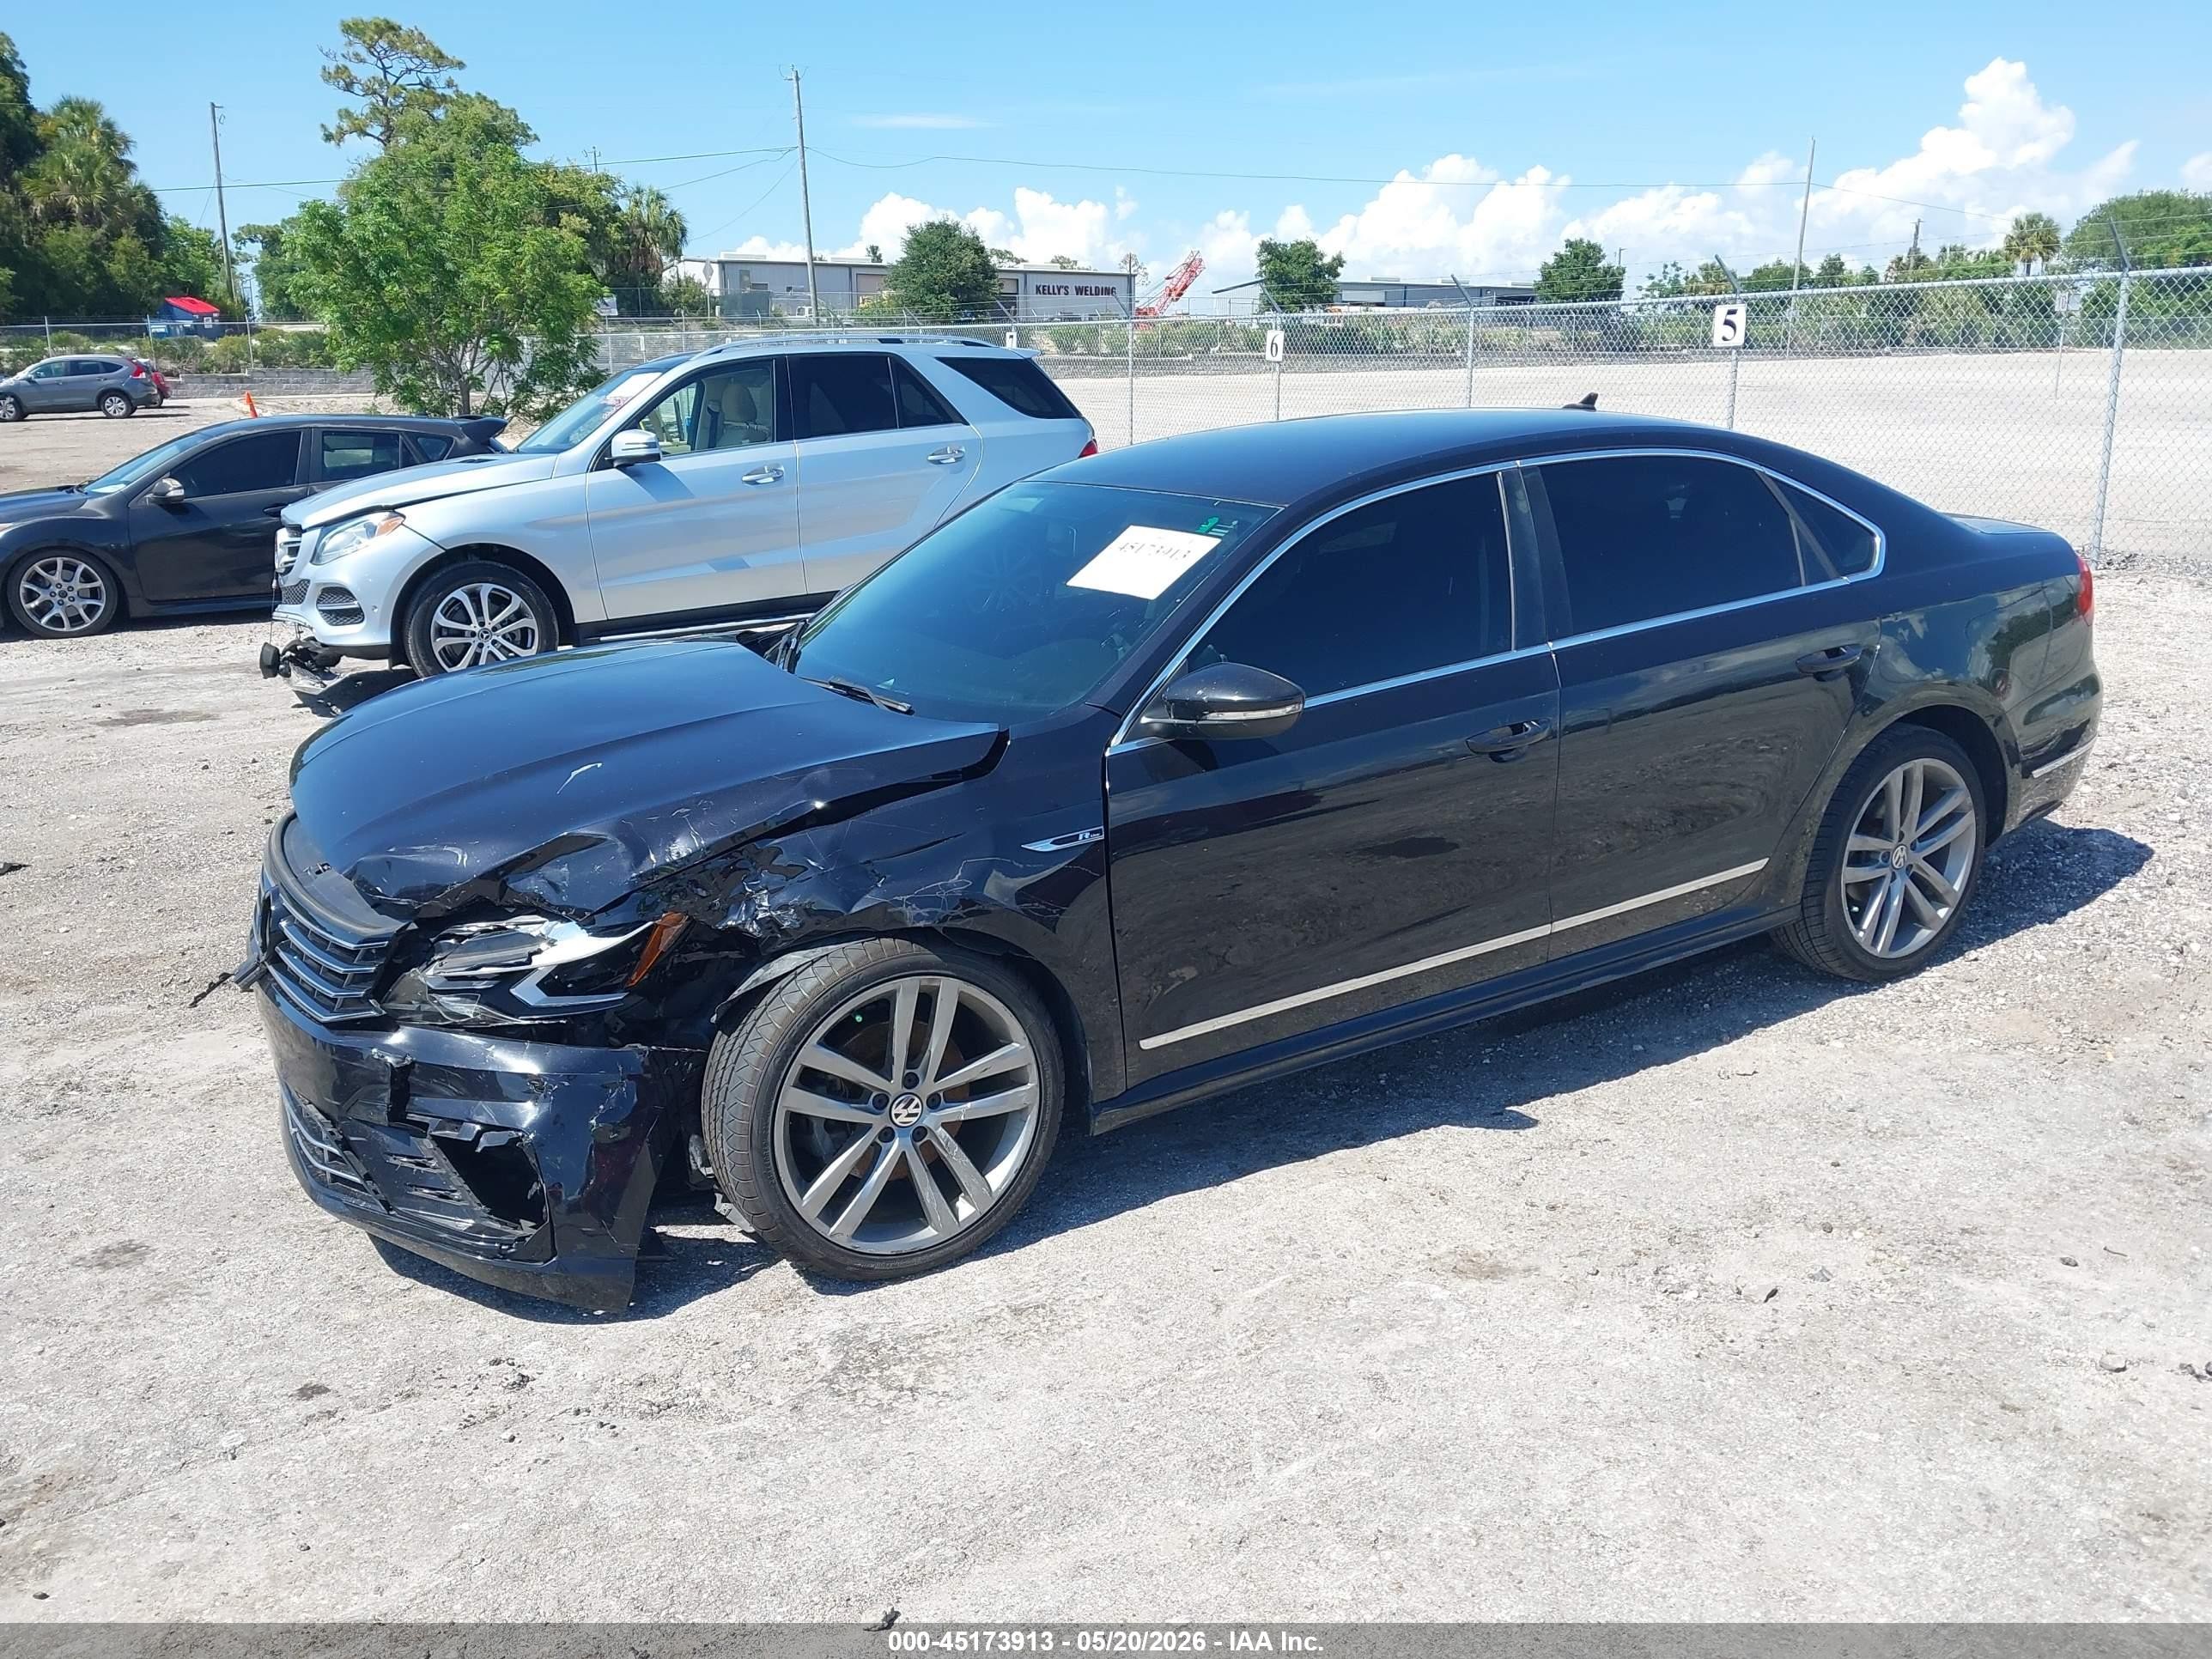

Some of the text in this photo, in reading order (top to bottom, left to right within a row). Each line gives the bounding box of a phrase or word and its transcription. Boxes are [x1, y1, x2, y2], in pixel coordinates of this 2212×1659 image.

[1036, 284, 1116, 296] KELLY'S WELDING
[1722, 308, 1738, 342] 5
[1270, 333, 1279, 358] 6
